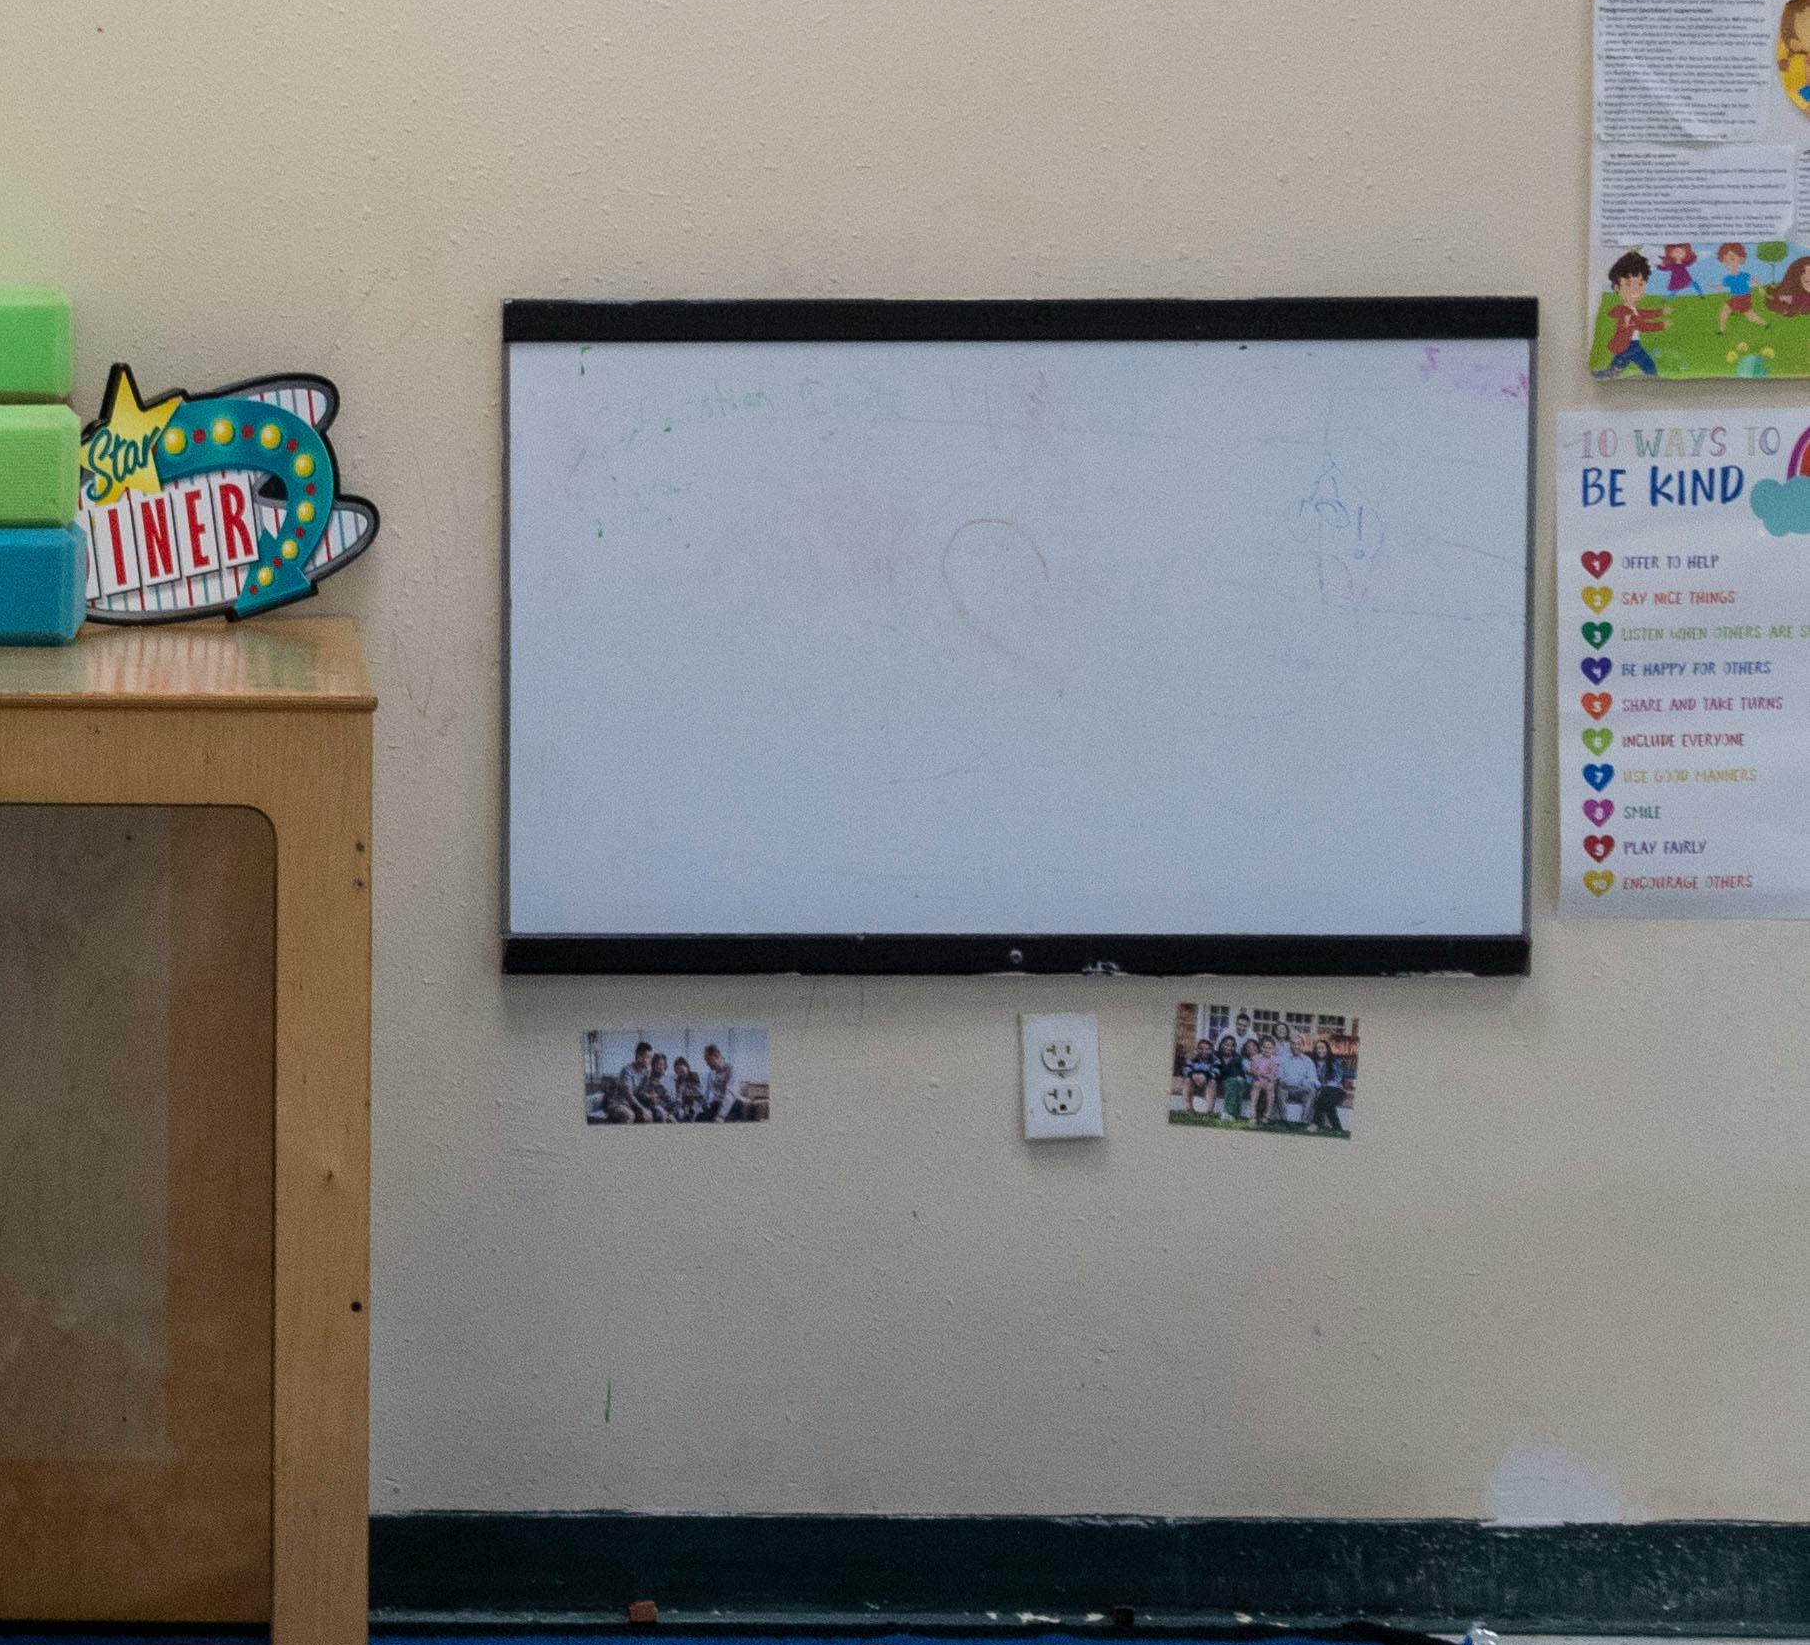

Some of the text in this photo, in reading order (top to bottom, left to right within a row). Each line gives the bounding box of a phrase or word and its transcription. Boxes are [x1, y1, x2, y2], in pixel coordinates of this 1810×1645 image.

[1580, 426, 1782, 459] 10 WAYS TO
[86, 426, 161, 502] Star
[1582, 465, 1745, 507] BE KIND
[107, 482, 254, 586] INER
[1622, 556, 1660, 570] OFFER
[1667, 556, 1681, 570] TO
[1686, 554, 1720, 570] HELP
[1621, 592, 1647, 606] SAY
[1654, 591, 1683, 605] NICE
[1689, 591, 1736, 605] THINGS
[1621, 627, 1664, 642] LISTEN
[1621, 662, 1636, 677] BE
[1642, 661, 1687, 677] HAPPY
[1693, 661, 1716, 675] FOR
[1724, 660, 1772, 675] OTHERS
[1621, 698, 1663, 713] SHARE
[1669, 698, 1697, 712] AND
[1702, 696, 1734, 711] TAKE
[1741, 696, 1784, 711] TURNS
[1622, 734, 1676, 749] INCLUDE
[1681, 732, 1746, 748] EVERYONE
[1623, 770, 1648, 783] USE
[1695, 768, 1758, 782] MANNERS
[1623, 805, 1662, 820] SMILE
[1623, 841, 1658, 855] PLAY
[1663, 840, 1708, 855] FAIRLY
[1622, 875, 1700, 891] ENCOURAGE
[1705, 875, 1754, 890] OTHERS
